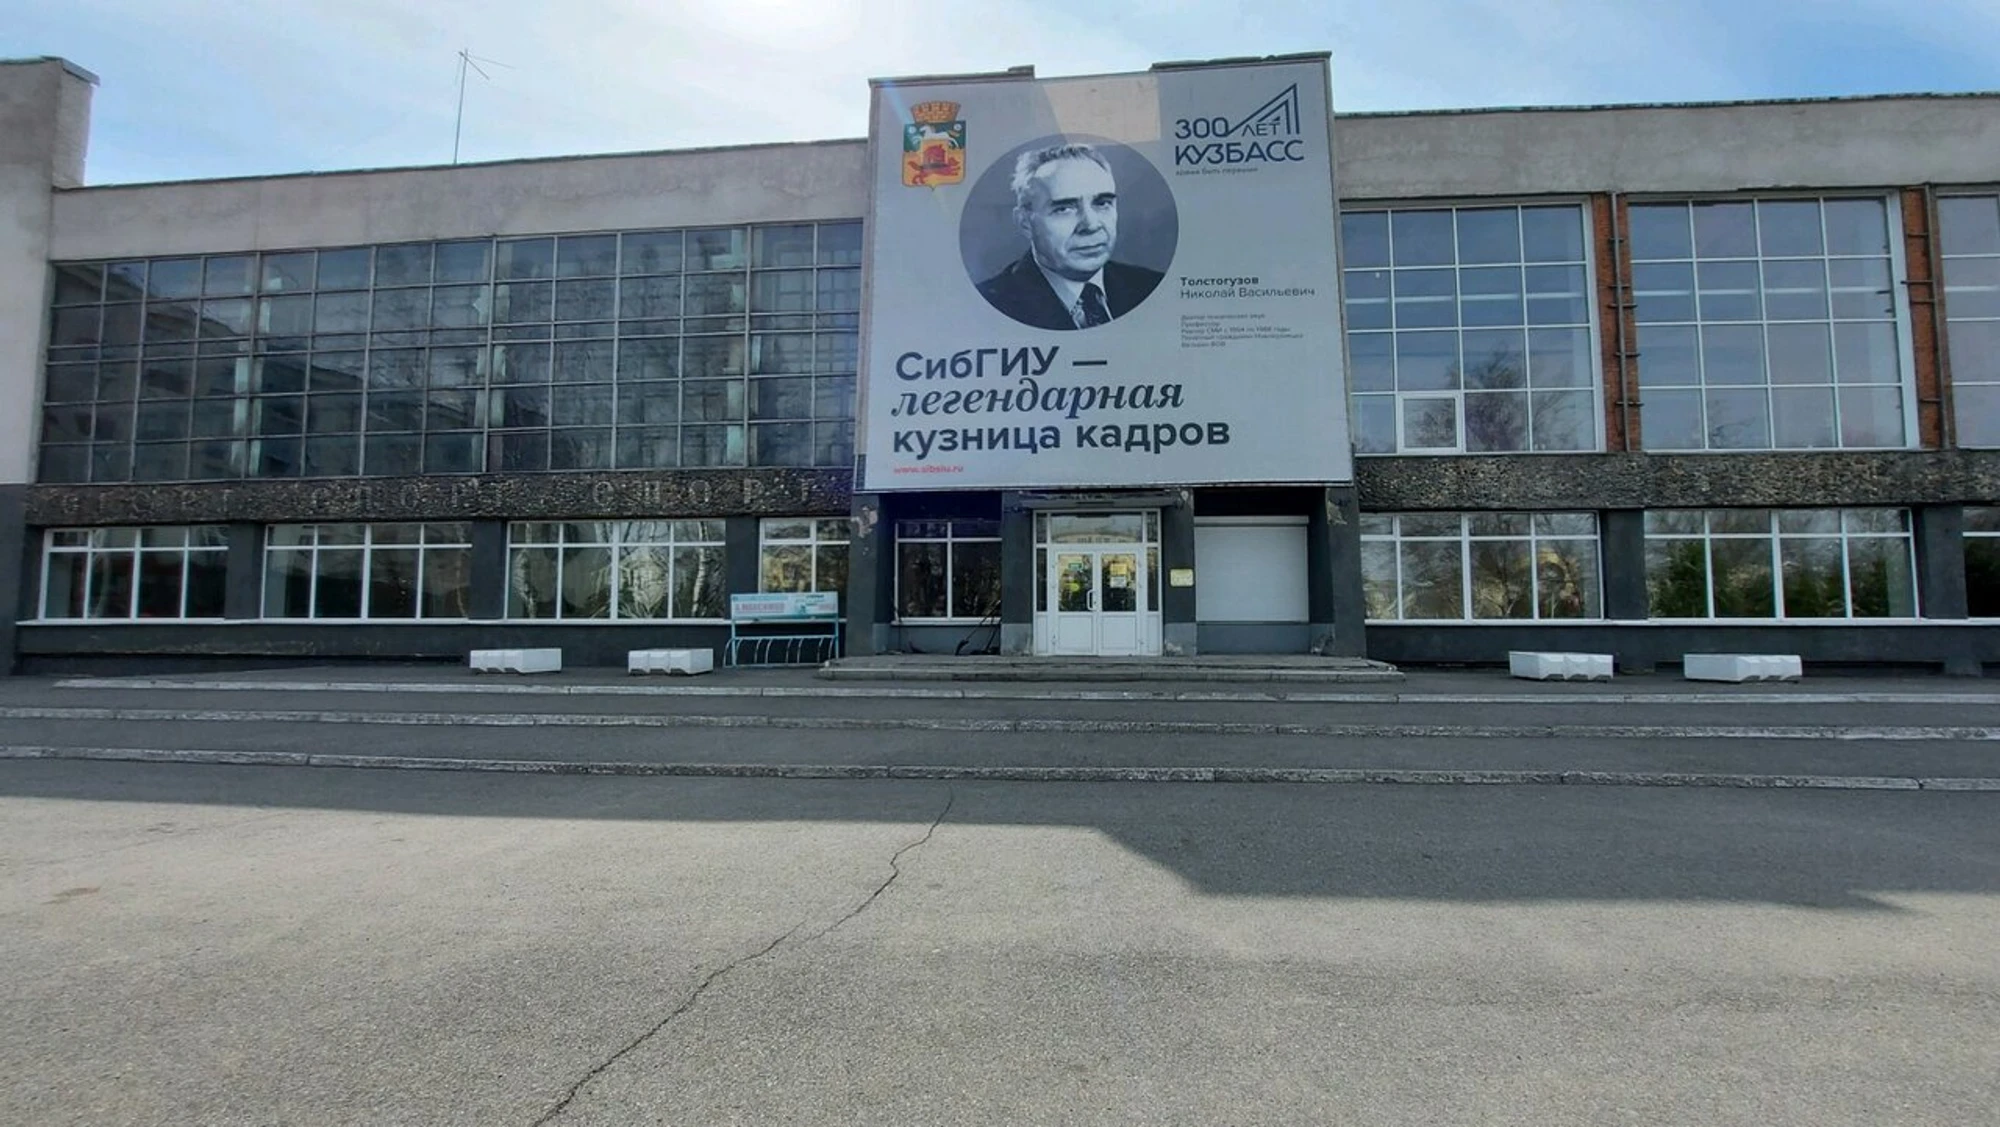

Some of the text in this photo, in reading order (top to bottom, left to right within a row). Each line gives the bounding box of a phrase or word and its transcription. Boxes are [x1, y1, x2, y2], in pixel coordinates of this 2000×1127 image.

[1175, 117, 1281, 139] 300 ЛЕТ
[1175, 139, 1304, 166] КУЗБАСС
[1180, 276, 1260, 287] Толстогузов
[1181, 287, 1316, 299] Николай Васильевич
[896, 346, 1060, 380] СибГИУ
[891, 377, 1184, 419] легендарная
[894, 422, 1230, 460] кузница кадров
